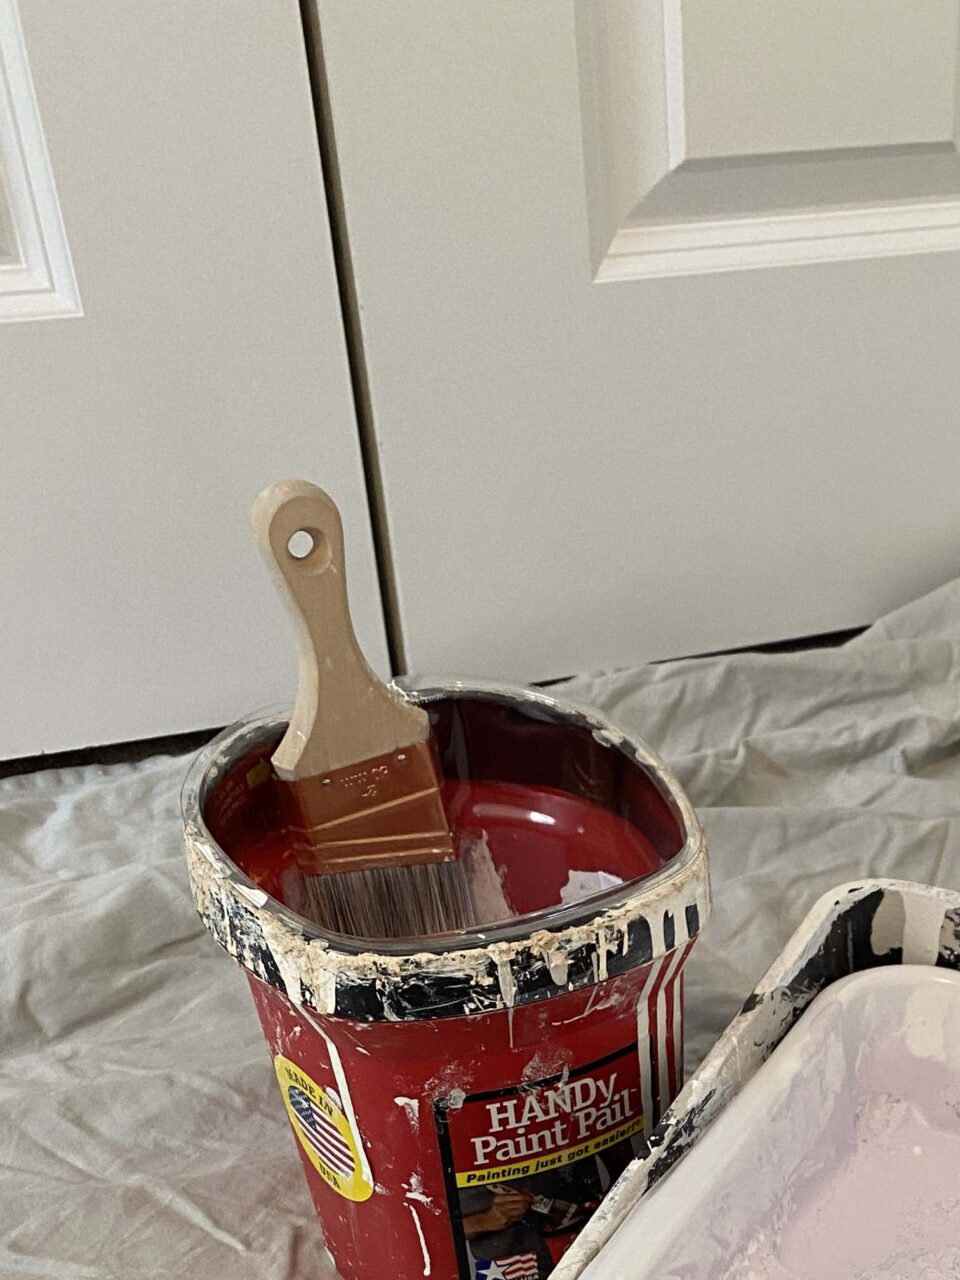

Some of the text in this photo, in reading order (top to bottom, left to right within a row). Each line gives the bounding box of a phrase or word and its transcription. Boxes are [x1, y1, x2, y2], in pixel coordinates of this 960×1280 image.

[285, 1067, 334, 1117] MADE IN
[470, 1118, 570, 1166] Paint
[318, 1161, 342, 1189] USA
[466, 1165, 531, 1183] Painting
[534, 1155, 563, 1171] just
[567, 1145, 591, 1157] got
